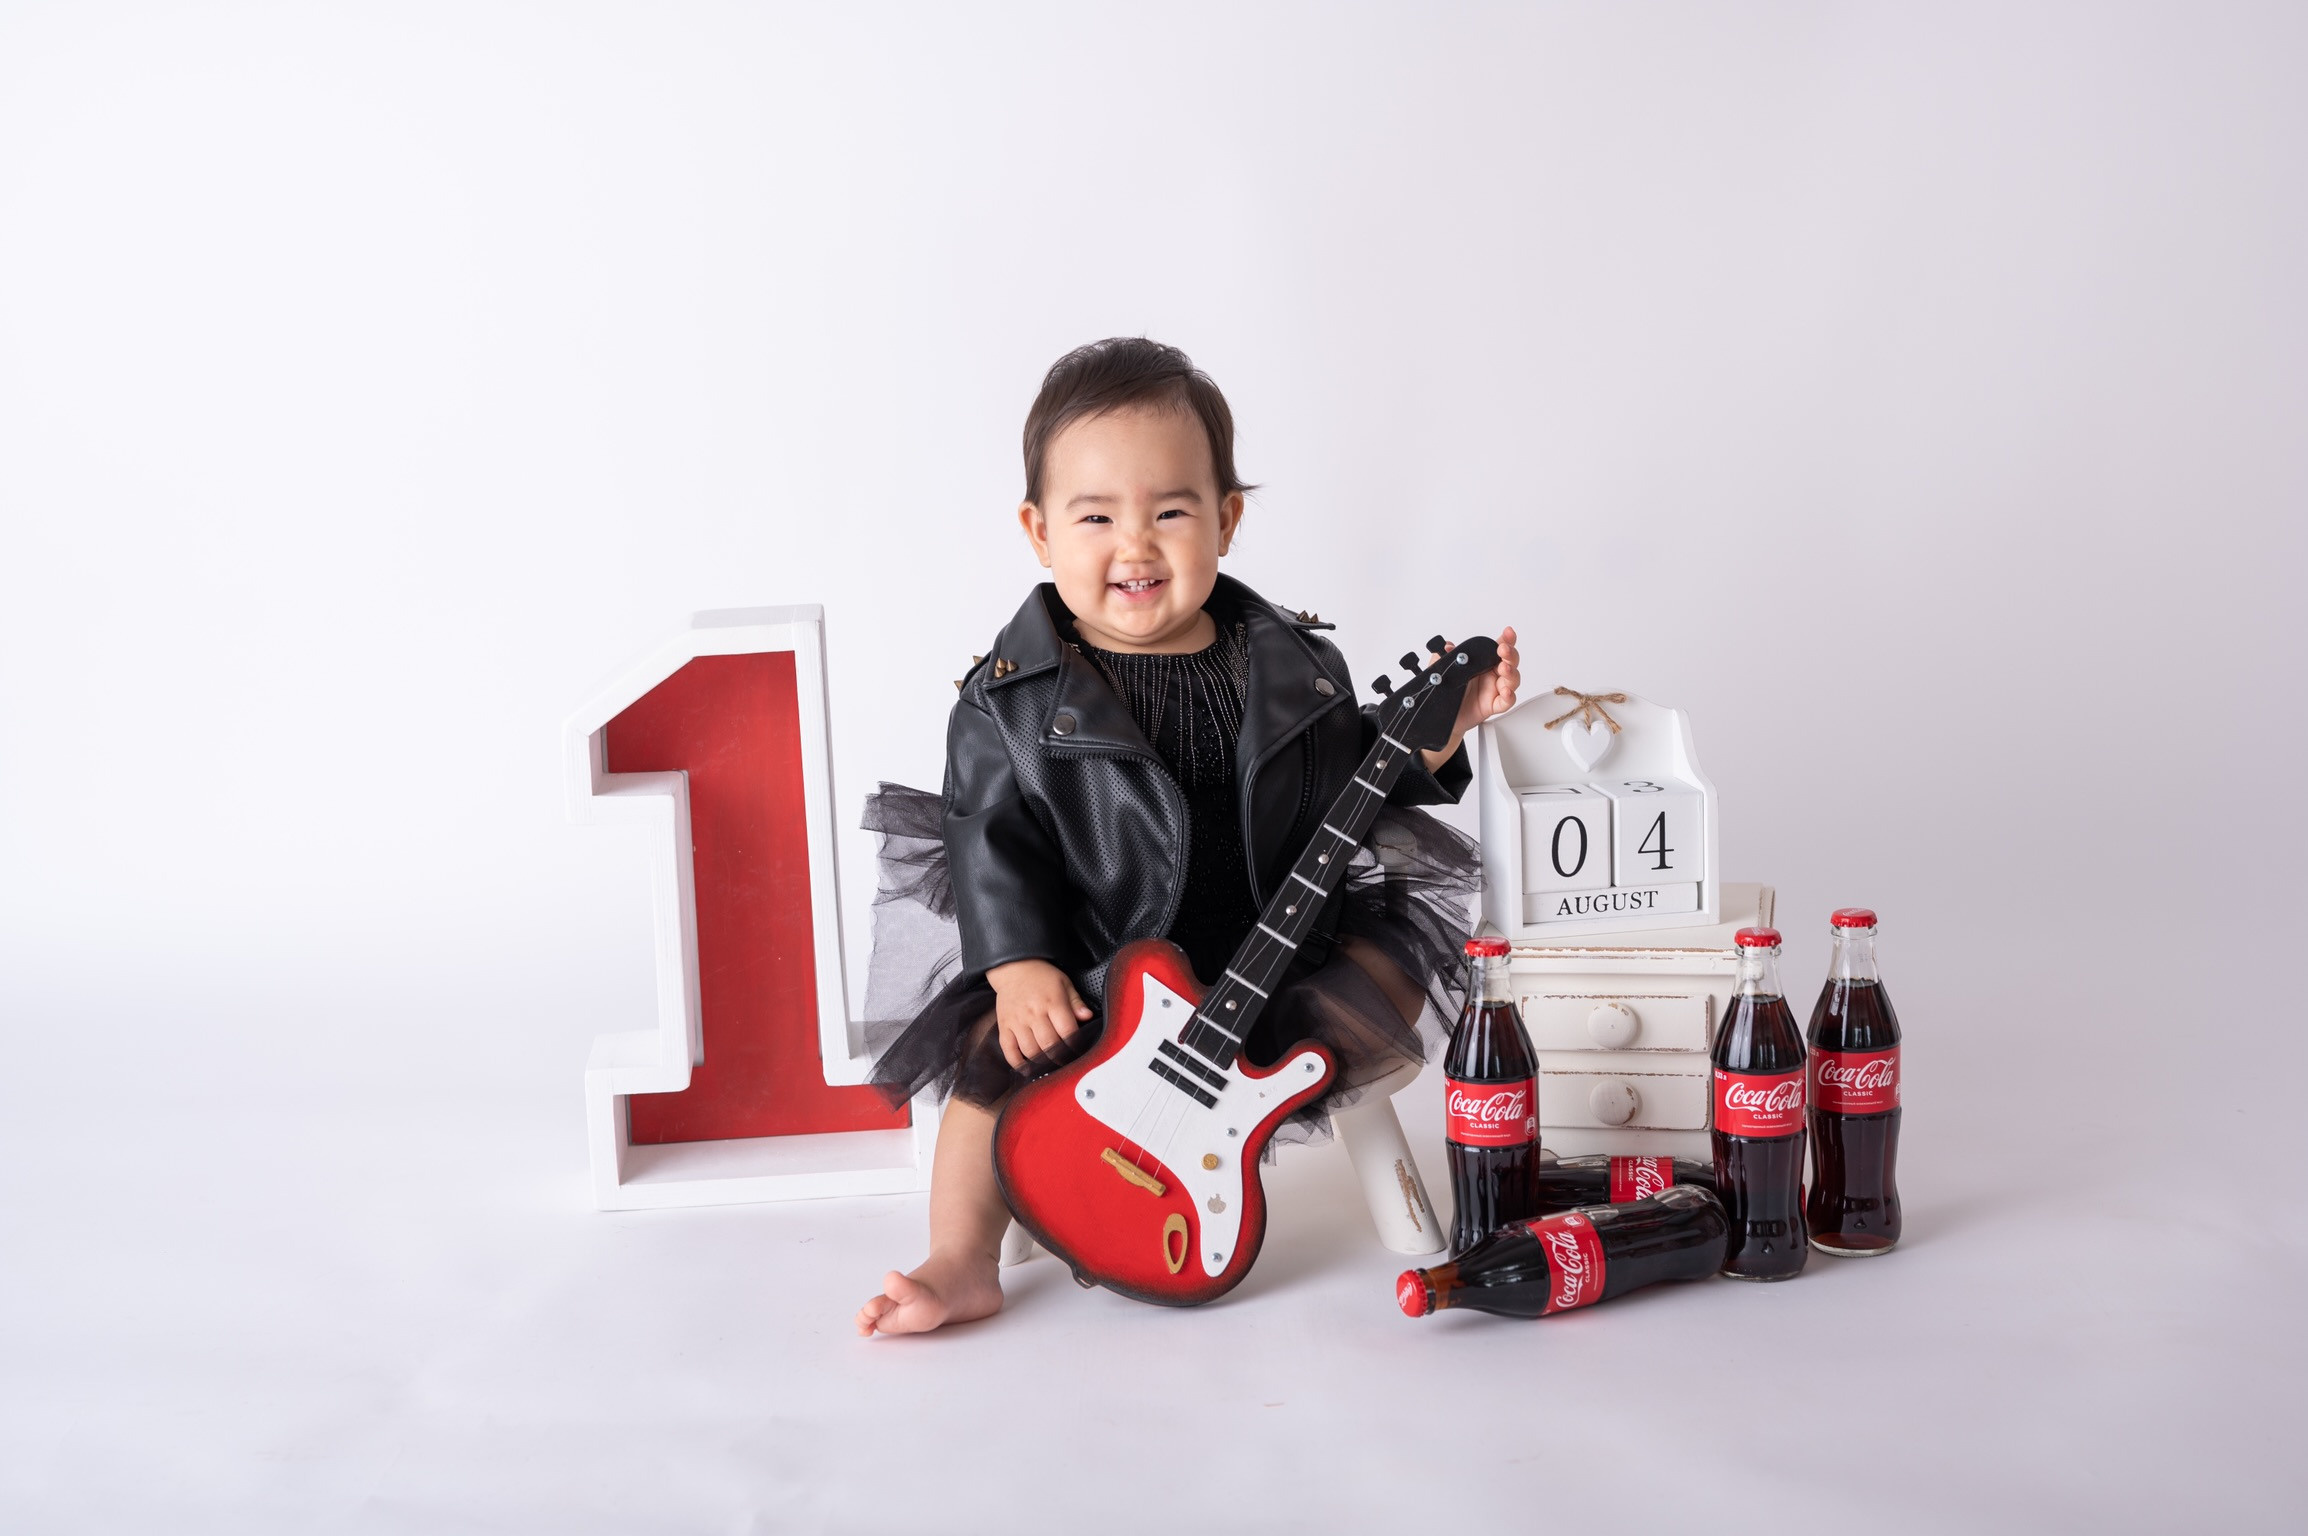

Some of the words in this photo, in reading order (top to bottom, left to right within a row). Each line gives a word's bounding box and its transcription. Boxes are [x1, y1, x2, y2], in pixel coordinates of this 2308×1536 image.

[1623, 780, 1665, 794] 3
[563, 604, 937, 1212] 1
[1556, 891, 1659, 916] AUGUST
[1818, 1056, 1896, 1090] Coca-Cola
[1449, 1089, 1527, 1122] Coca-Cola
[1725, 1079, 1804, 1113] Coca-Cola
[1543, 1230, 1584, 1308] Coca-Cola
[1582, 1253, 1591, 1284] CLASSIC
